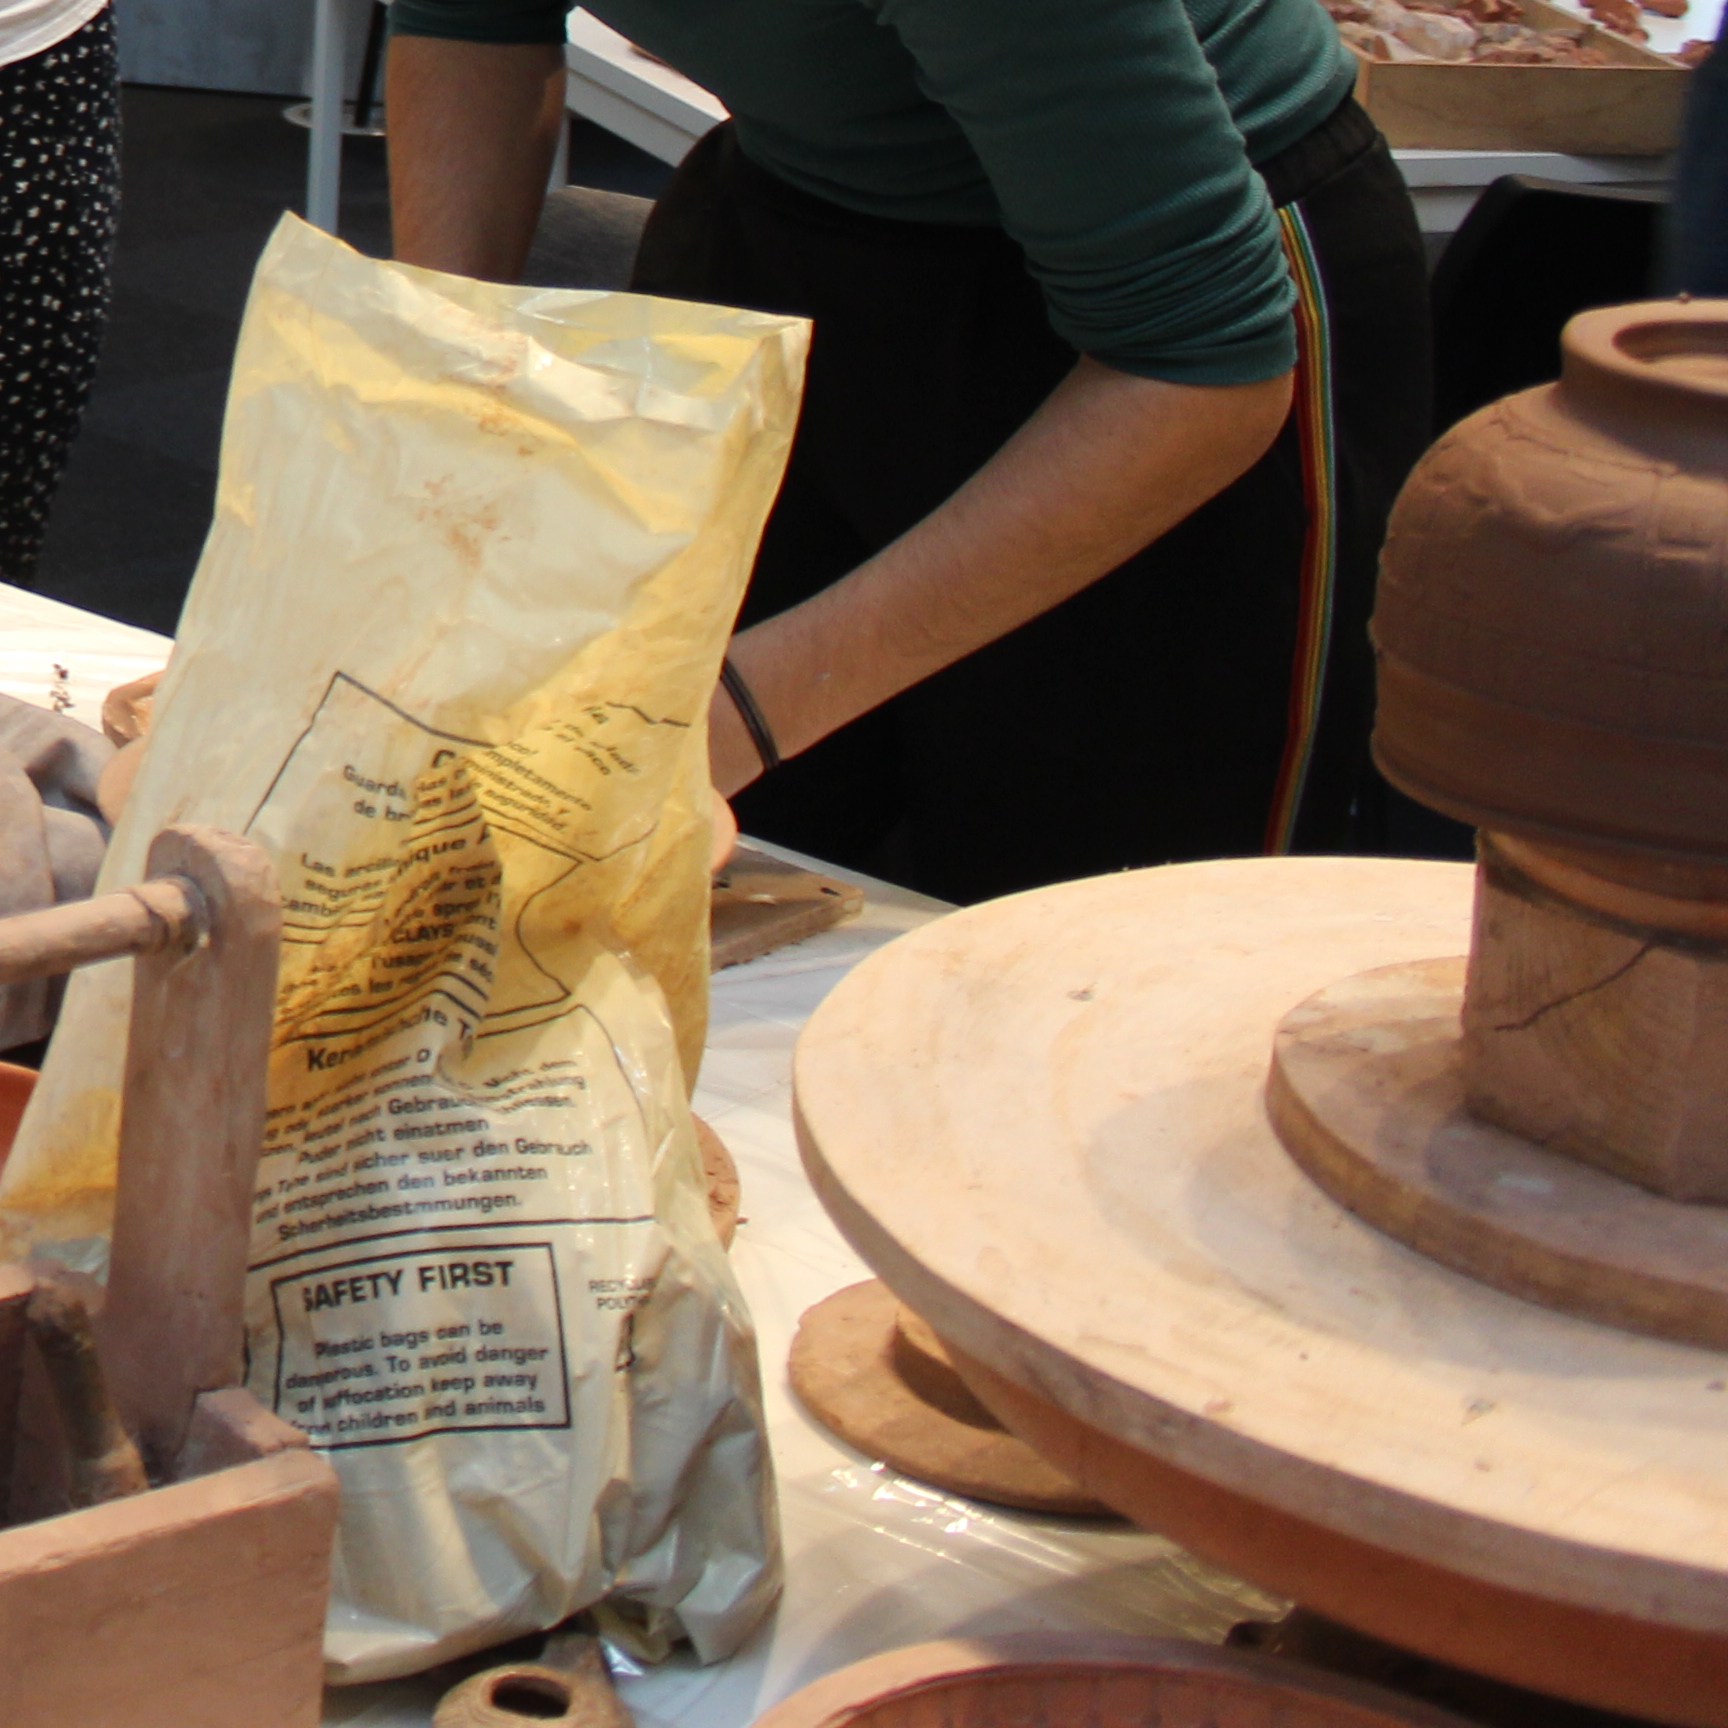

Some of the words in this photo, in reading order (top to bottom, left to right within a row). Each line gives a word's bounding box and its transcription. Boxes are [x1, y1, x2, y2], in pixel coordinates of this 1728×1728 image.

[303, 1268, 405, 1312] SAFETY
[418, 1260, 515, 1292] FIRST
[314, 1337, 374, 1359] Plastic
[380, 1329, 430, 1351] bags
[436, 1321, 471, 1339] can
[479, 1319, 504, 1336] be
[385, 1354, 411, 1373] To
[419, 1346, 467, 1370] avoid
[475, 1342, 549, 1367] danger
[483, 1371, 538, 1391] away
[464, 1395, 545, 1416] animals
